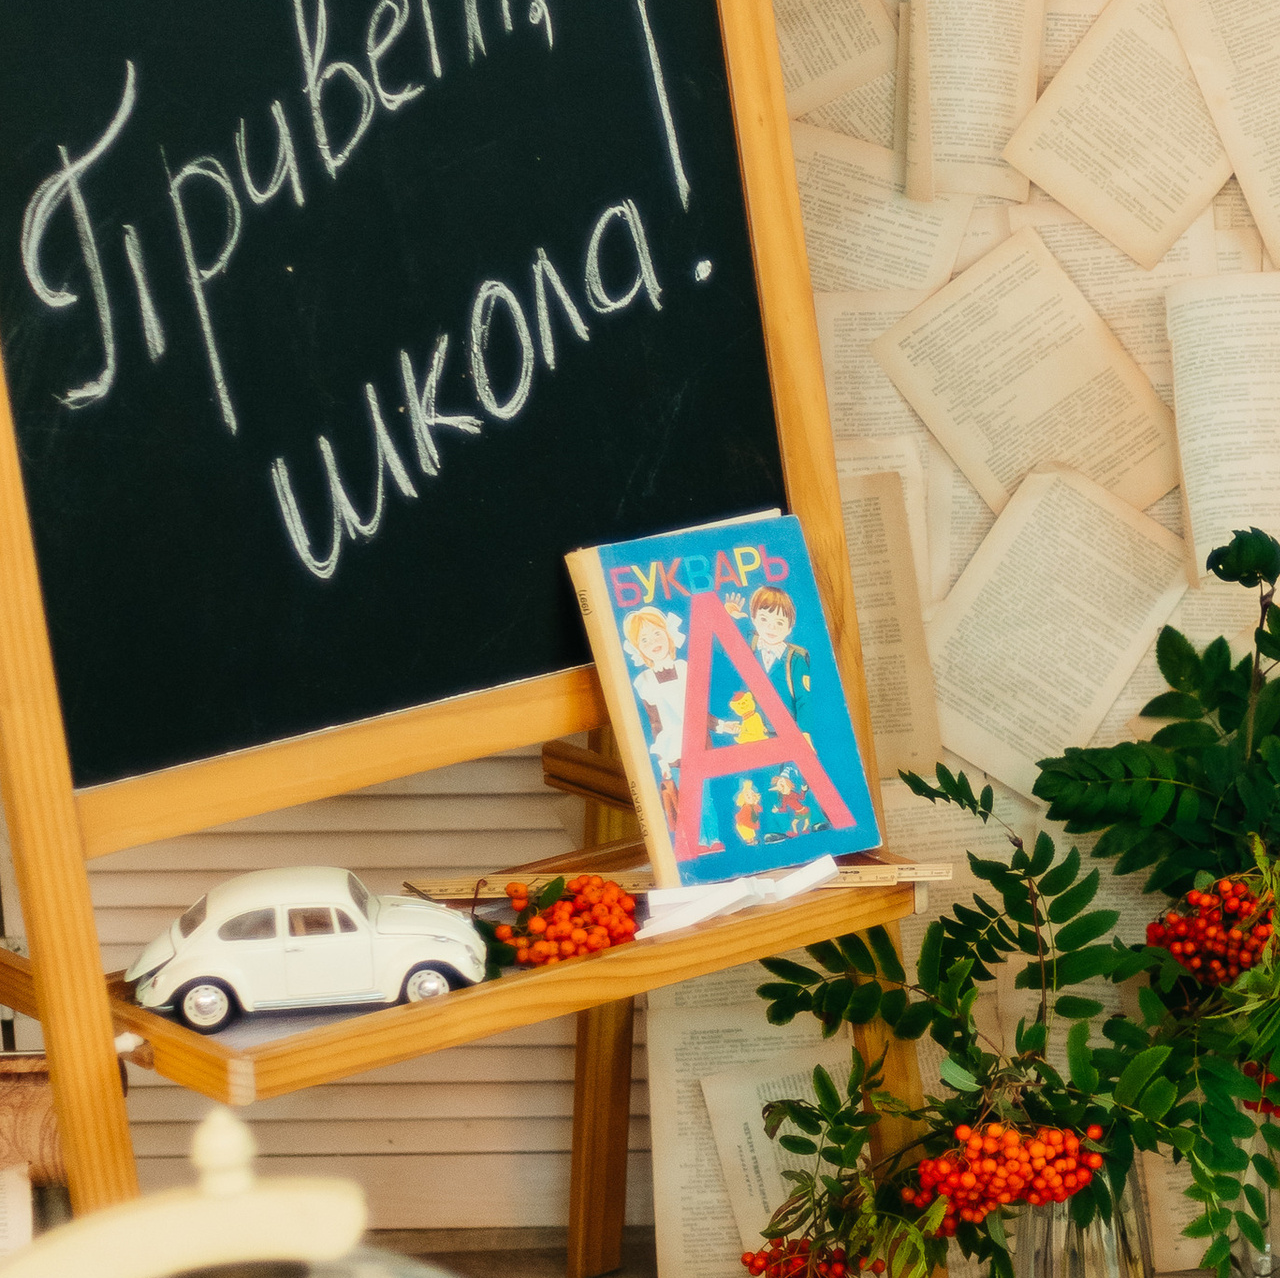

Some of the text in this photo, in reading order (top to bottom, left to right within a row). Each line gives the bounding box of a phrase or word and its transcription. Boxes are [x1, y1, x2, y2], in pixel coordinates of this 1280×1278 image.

[578, 589, 593, 616] (1991)
[609, 544, 789, 608] БУКВАРЬ
[674, 590, 858, 862] А
[630, 780, 649, 838] БУКВАРЬ
